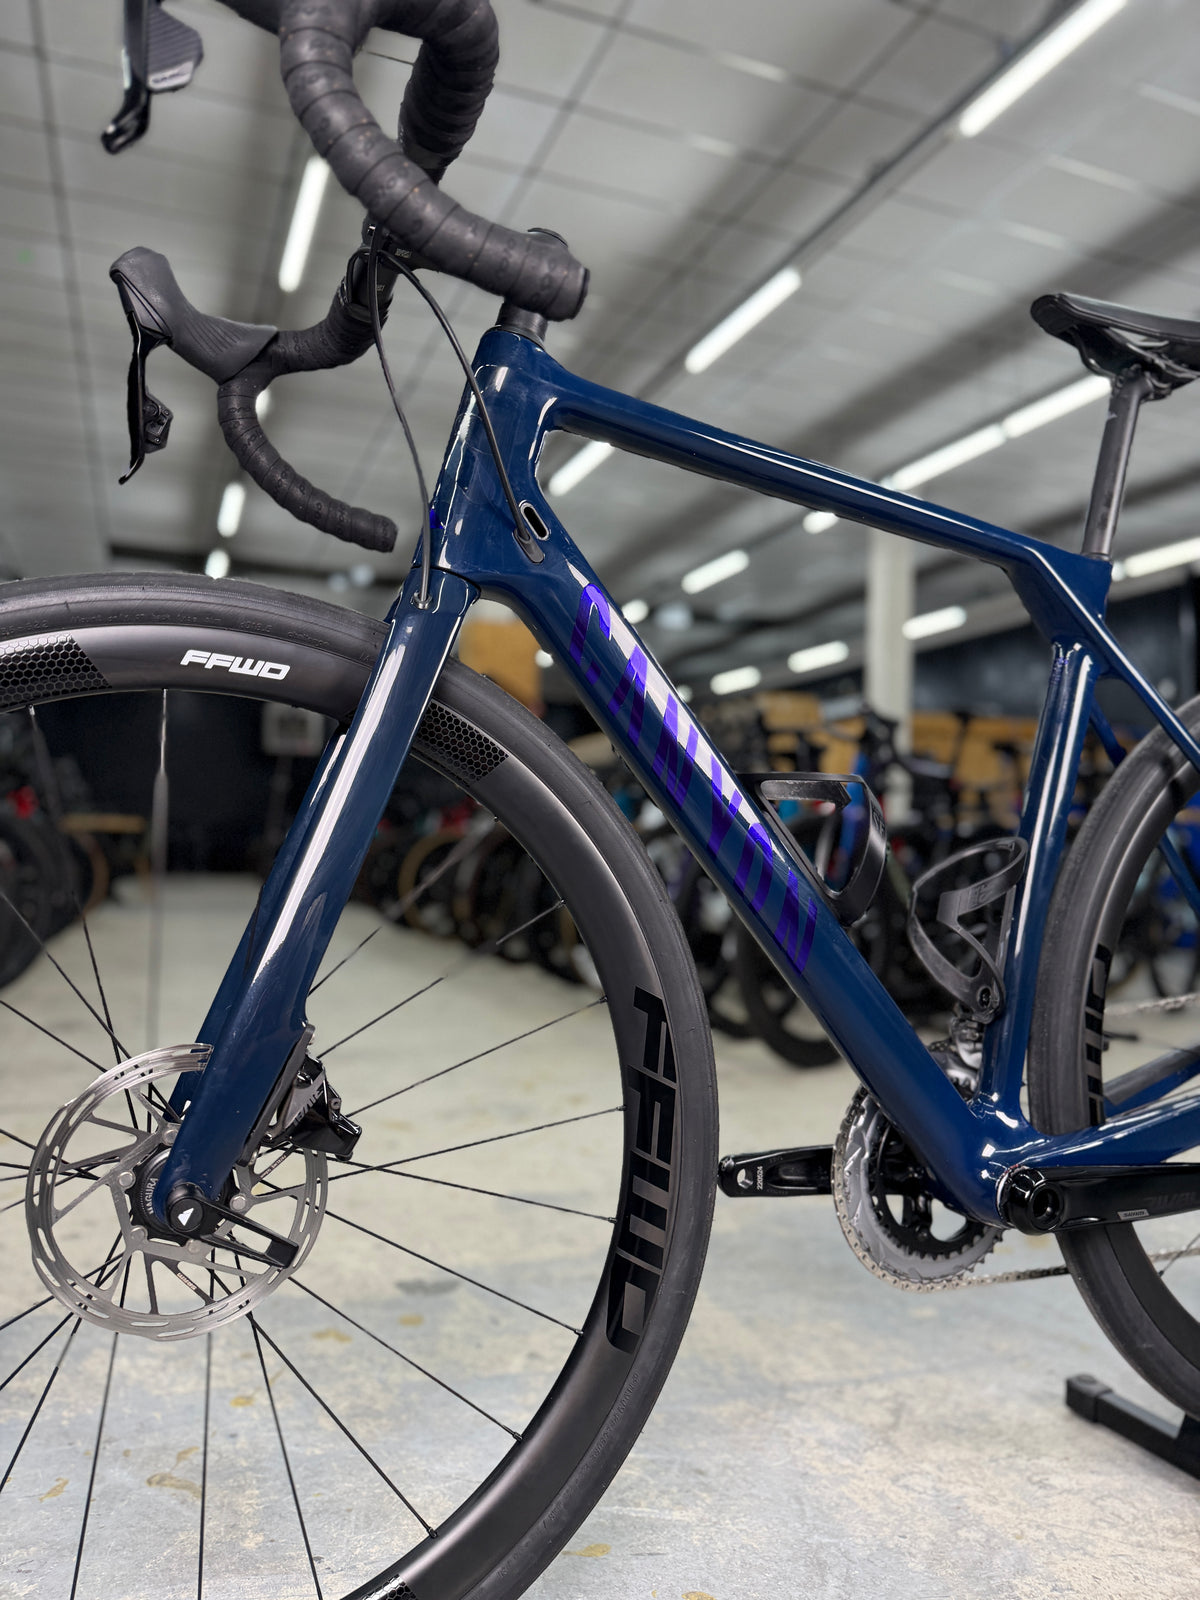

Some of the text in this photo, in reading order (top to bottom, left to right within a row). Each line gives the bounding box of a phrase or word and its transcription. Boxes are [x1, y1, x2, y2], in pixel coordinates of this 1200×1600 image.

[180, 649, 290, 680] FFWD
[568, 583, 818, 974] CANYON
[144, 1177, 160, 1215] MAGURA
[606, 985, 678, 1354] FFWD
